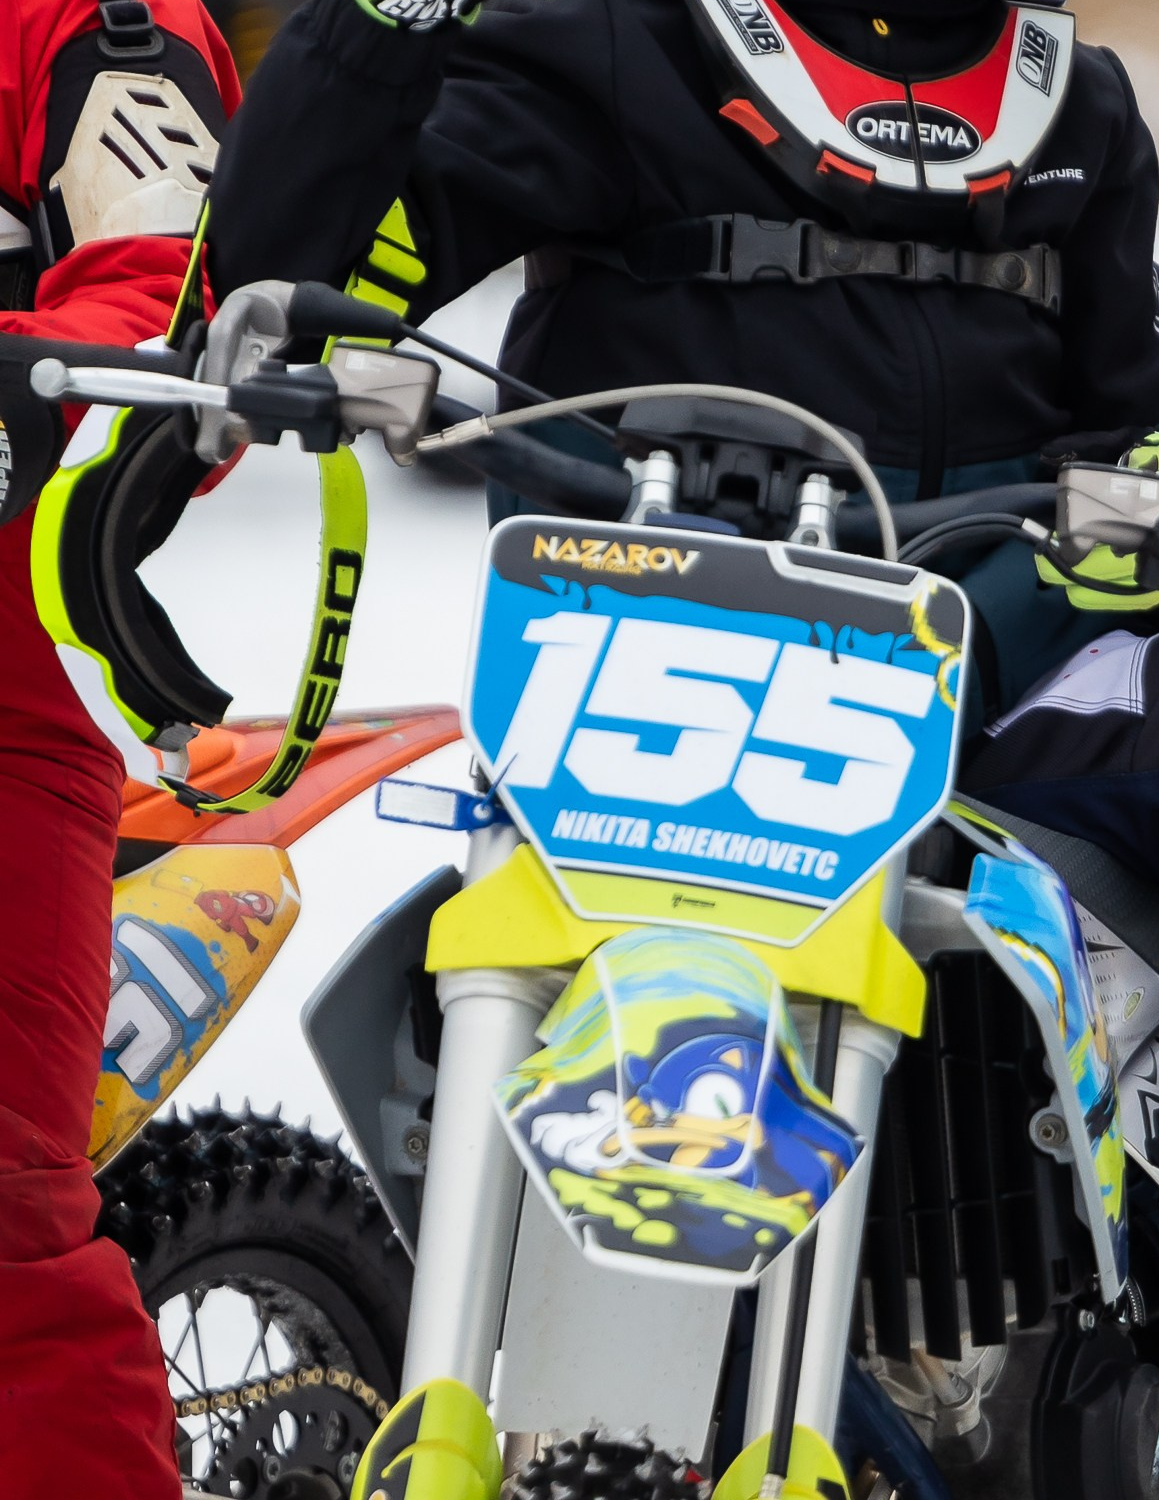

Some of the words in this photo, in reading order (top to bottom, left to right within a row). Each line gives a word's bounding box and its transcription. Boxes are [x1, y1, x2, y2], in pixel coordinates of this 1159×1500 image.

[1018, 22, 1047, 85] ONB
[856, 117, 973, 149] ORTEMA
[532, 534, 700, 575] NAZAROV
[492, 610, 938, 836] 155
[551, 809, 651, 849] NIKITA
[651, 821, 840, 881] SHEKHOVETC
